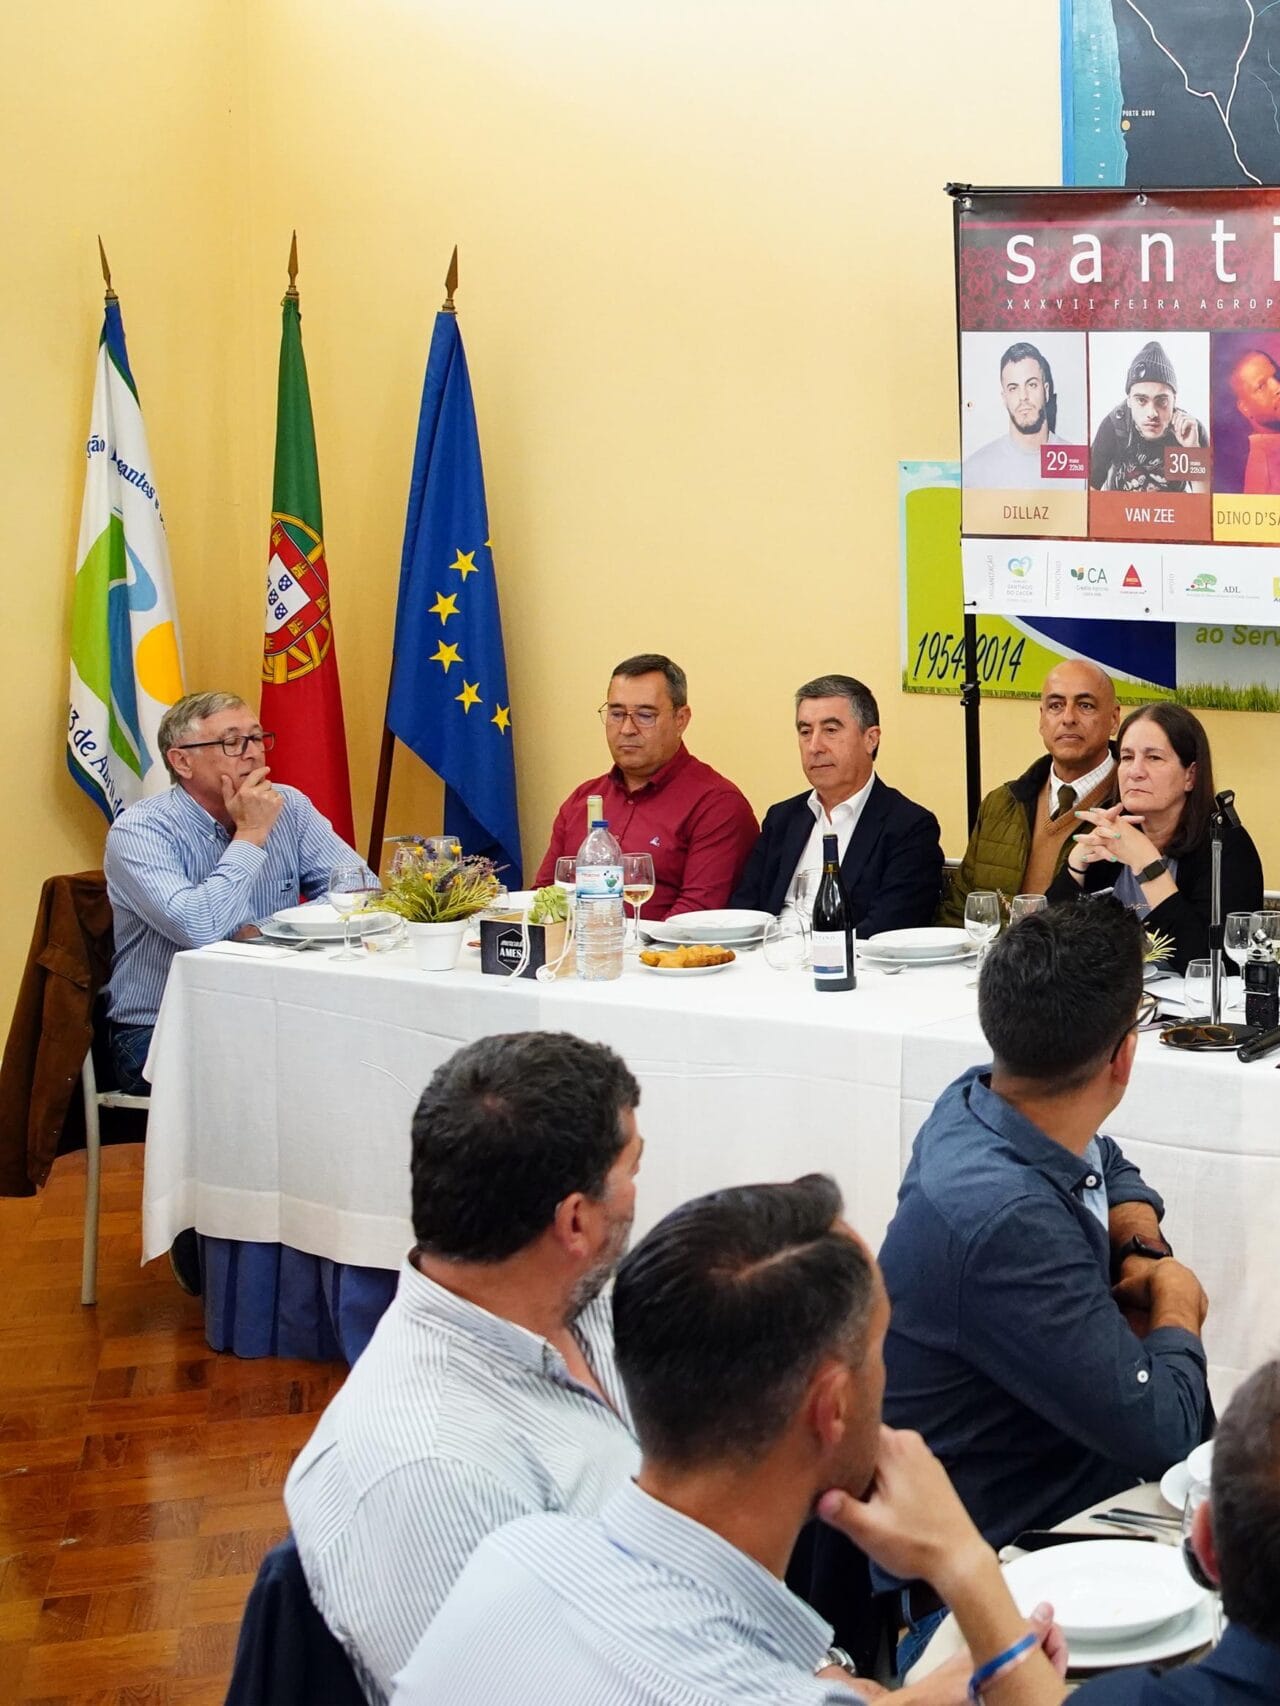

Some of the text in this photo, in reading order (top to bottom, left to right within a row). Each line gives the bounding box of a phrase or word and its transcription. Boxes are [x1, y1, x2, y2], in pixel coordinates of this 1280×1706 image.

[1006, 298, 1096, 311] XXXVII
[1113, 298, 1181, 310] FEIRA
[1046, 450, 1068, 471] 29
[1169, 453, 1189, 474] 30
[1003, 506, 1049, 520] DILLAZ
[1125, 508, 1176, 523] VAN ZEE
[1217, 511, 1251, 526] DINO
[1087, 567, 1108, 584] CA
[1223, 586, 1241, 594] ADL
[1195, 626, 1224, 644] ao
[73, 728, 97, 757] de
[500, 946, 522, 958] AMES
